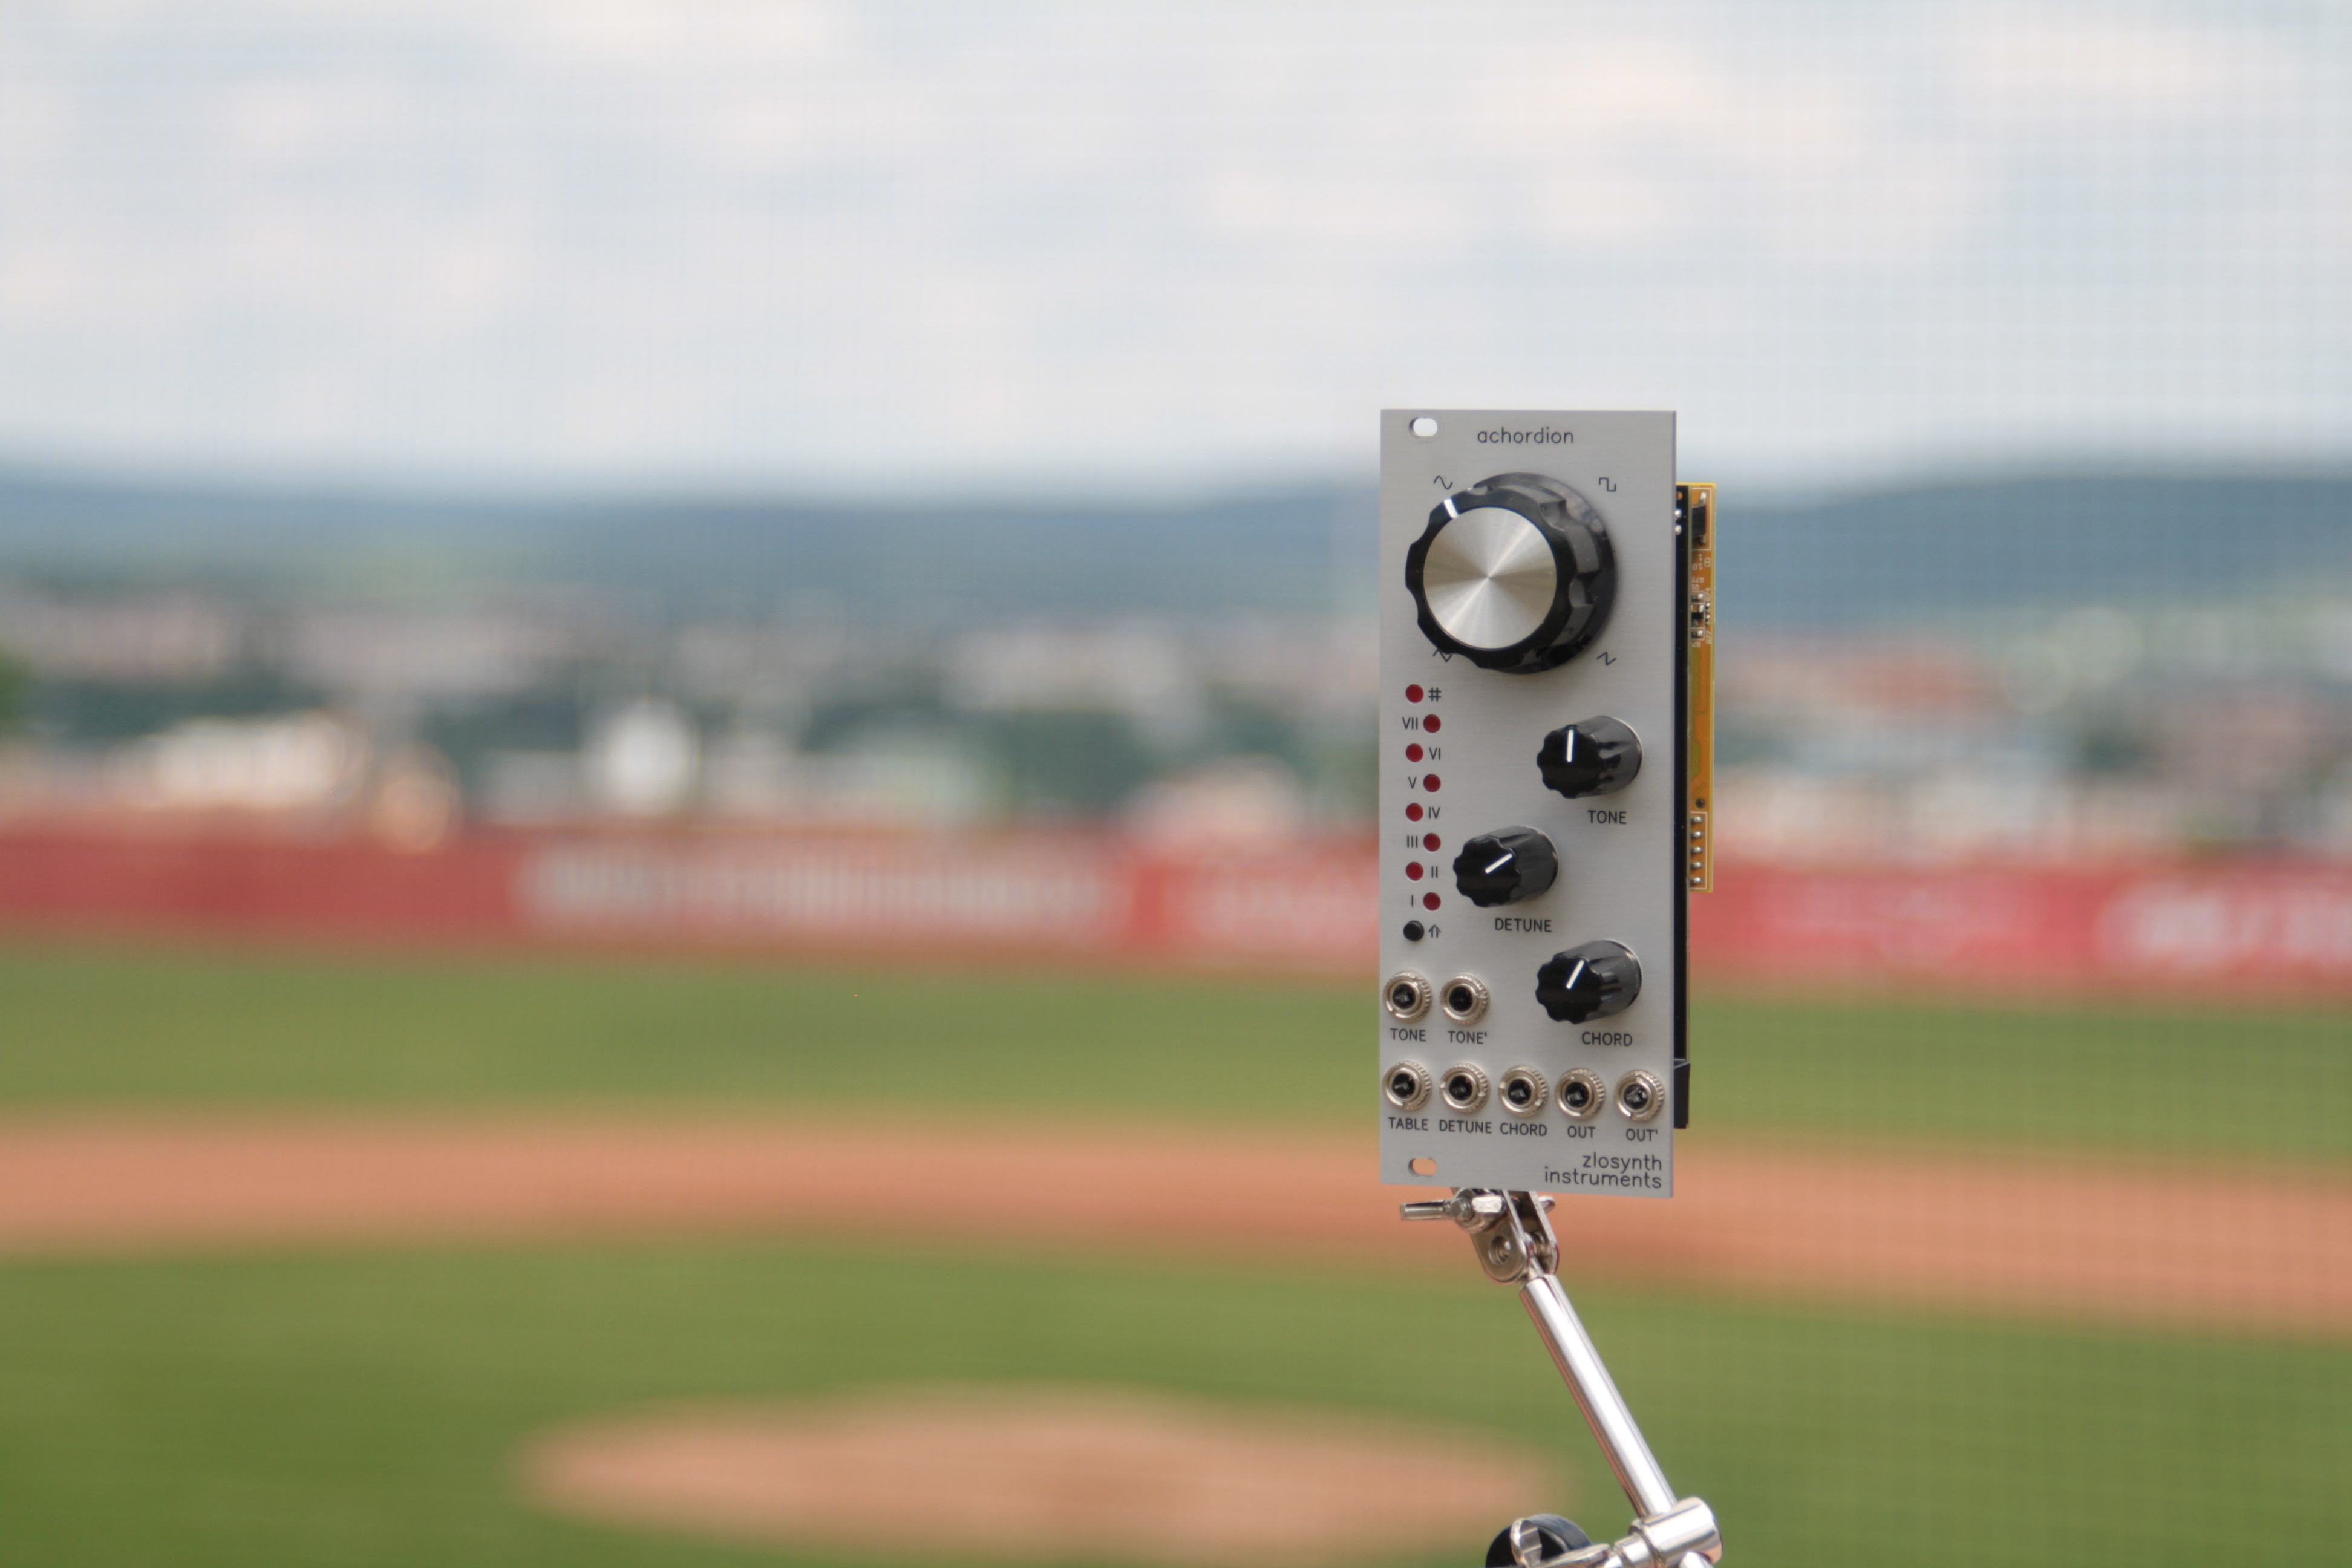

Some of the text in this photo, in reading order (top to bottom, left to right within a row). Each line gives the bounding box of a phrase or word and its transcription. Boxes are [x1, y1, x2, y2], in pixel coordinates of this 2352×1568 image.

[1477, 426, 1574, 445] achordion
[1402, 716, 1419, 730] VII
[1428, 747, 1441, 760] VI
[1408, 776, 1417, 789] V
[1428, 806, 1441, 820] IV
[1587, 809, 1627, 825] TONE
[1406, 835, 1419, 848] III
[1431, 866, 1439, 879] II
[1495, 917, 1552, 933] DETUNE
[1390, 1028, 1426, 1042] TONE
[1447, 1030, 1488, 1045] TONE'
[1581, 1031, 1633, 1047] CHORD
[1388, 1116, 1429, 1131] TABLE
[1439, 1120, 1492, 1134] DETUNE
[1500, 1122, 1547, 1137] CHORD
[1567, 1125, 1596, 1139] OUT
[1625, 1128, 1658, 1142] OUT'
[1582, 1151, 1662, 1174] zlosynth
[1544, 1166, 1662, 1189] instruments
